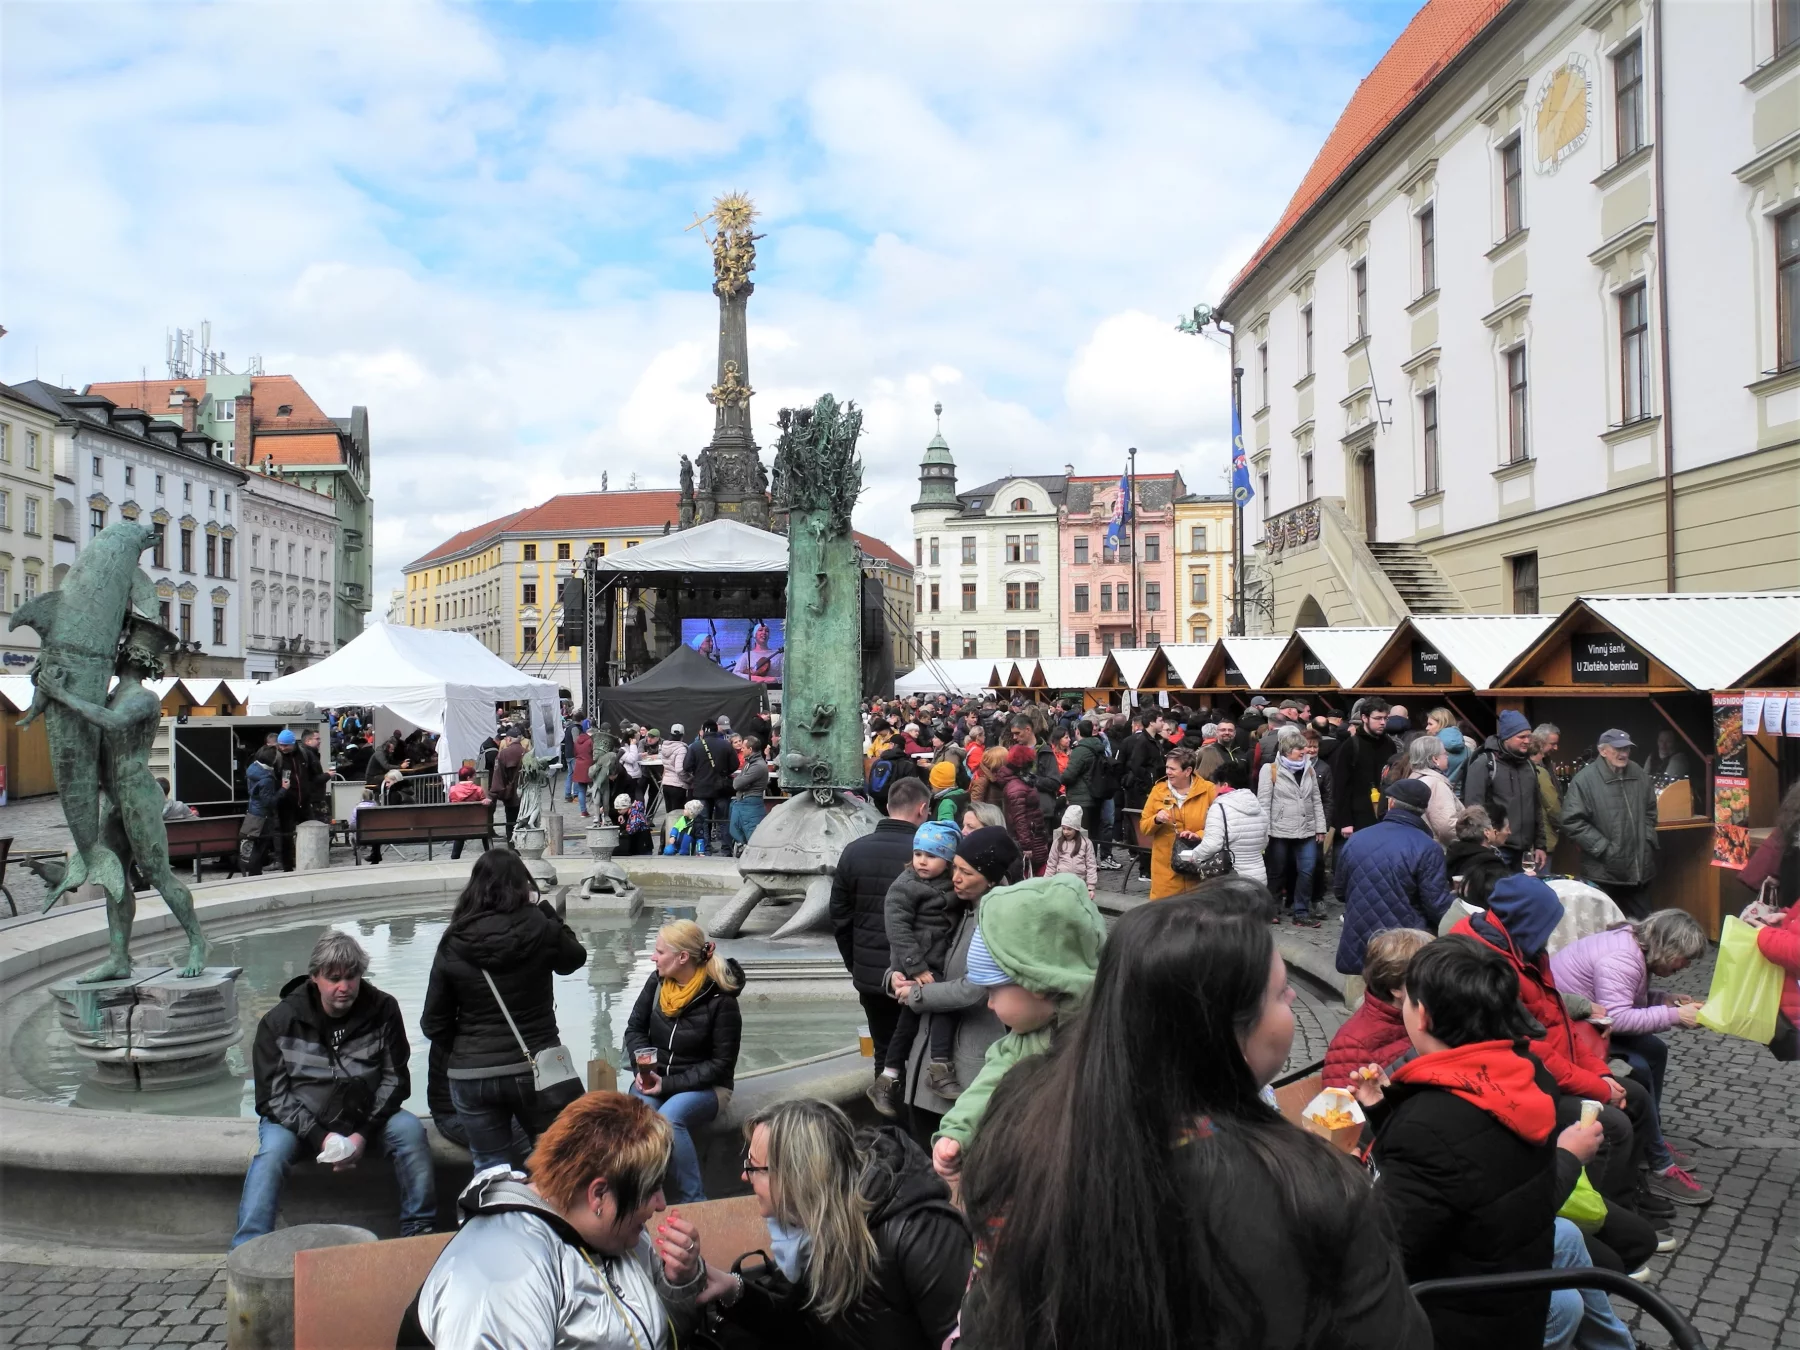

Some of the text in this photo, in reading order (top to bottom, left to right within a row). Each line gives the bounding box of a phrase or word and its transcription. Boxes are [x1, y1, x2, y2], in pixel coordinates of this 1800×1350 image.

[1588, 643, 1626, 656] Vinný šenk
[1420, 652, 1439, 660] Pivovar
[1576, 660, 1639, 671] U Zlatého beránka
